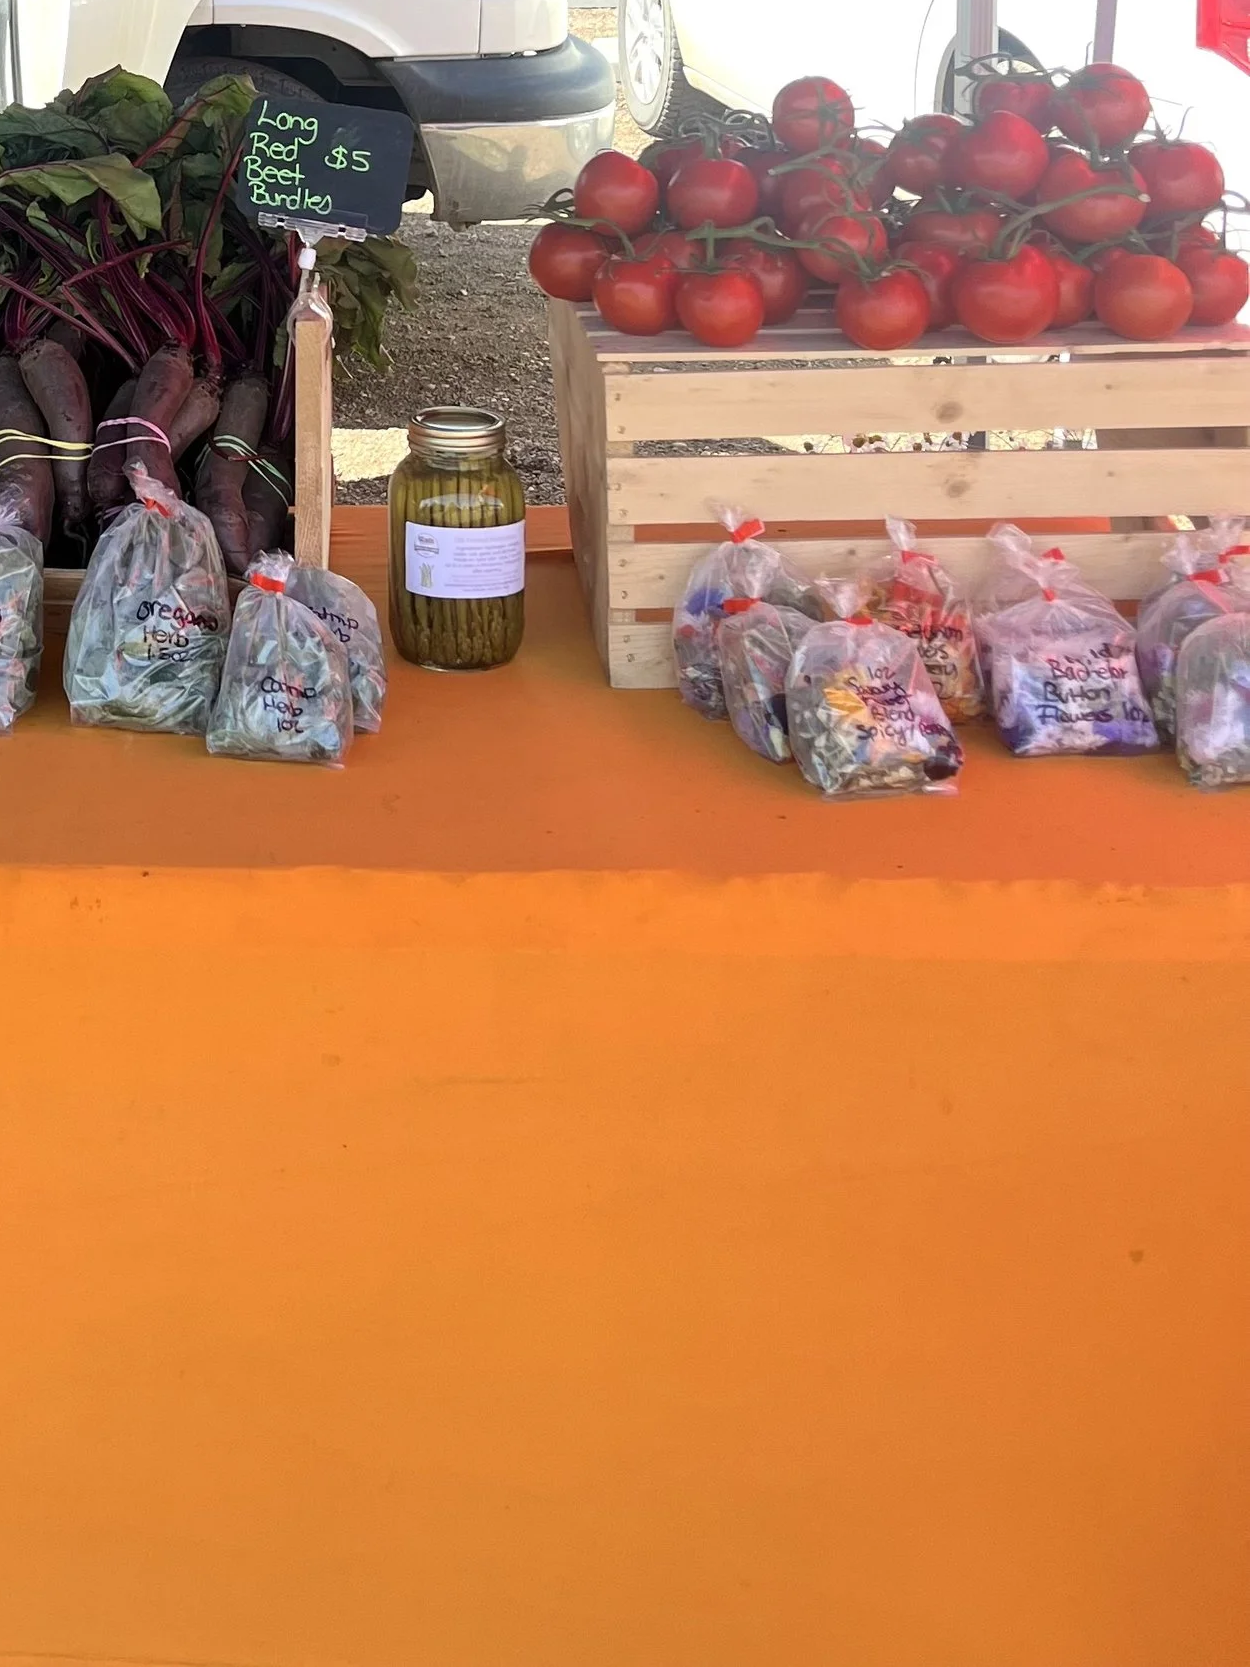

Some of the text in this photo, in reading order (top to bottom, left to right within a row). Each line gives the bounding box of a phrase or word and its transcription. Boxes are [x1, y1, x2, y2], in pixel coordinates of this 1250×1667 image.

[257, 100, 318, 145] Long
[250, 132, 299, 162] Red
[324, 145, 371, 172] $5
[243, 155, 305, 185] Beet
[248, 181, 332, 215] Bundles
[143, 626, 190, 648] Herb
